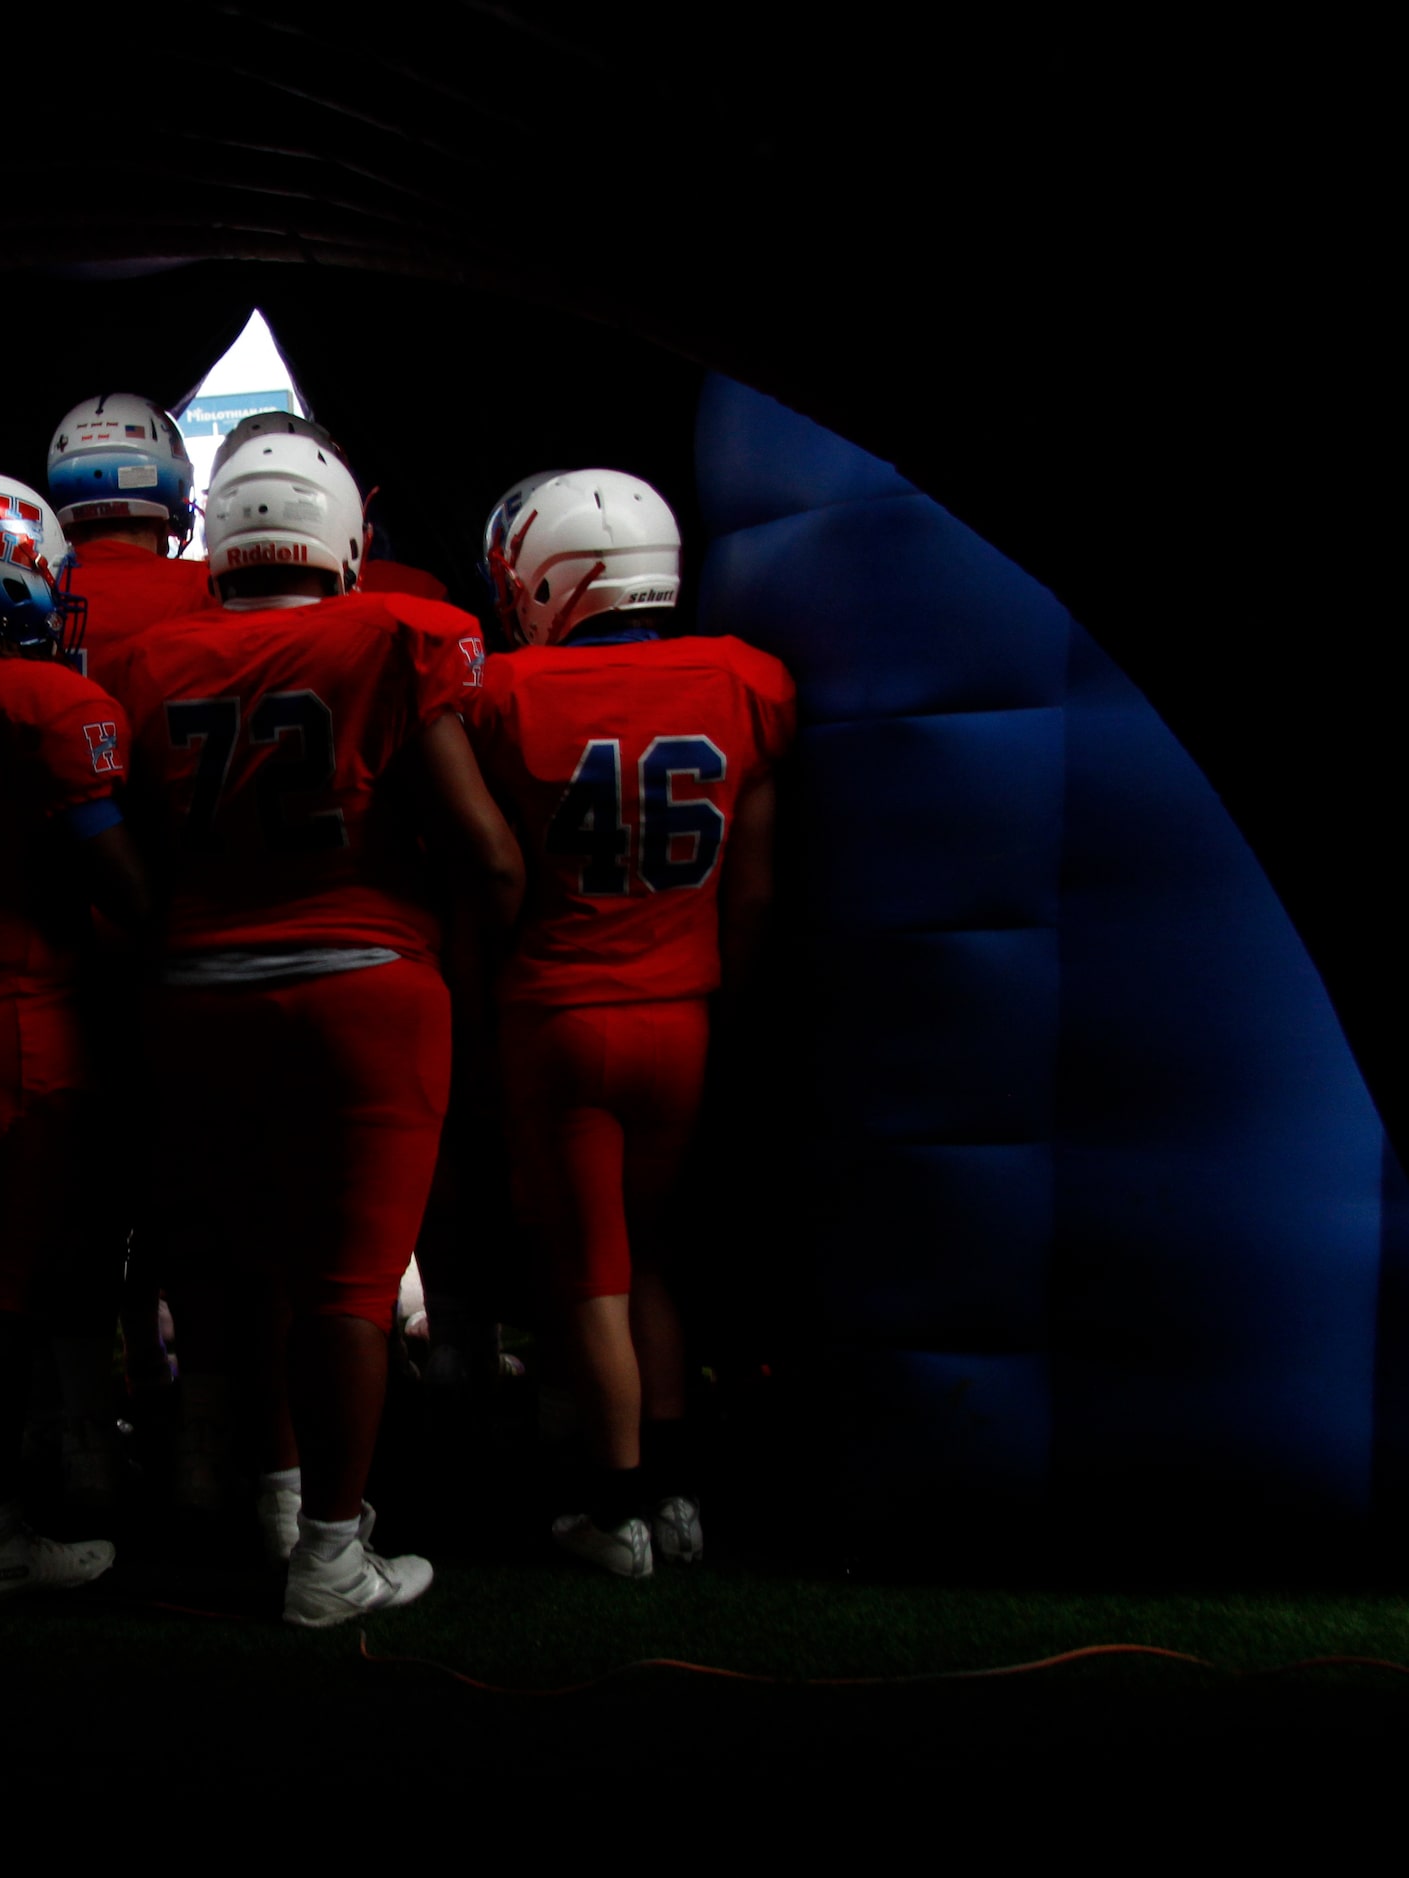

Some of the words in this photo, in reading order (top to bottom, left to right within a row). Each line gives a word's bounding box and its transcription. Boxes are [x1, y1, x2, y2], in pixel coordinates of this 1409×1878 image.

[227, 543, 308, 566] Riddell
[163, 688, 350, 855] 72
[543, 734, 727, 896] 46
